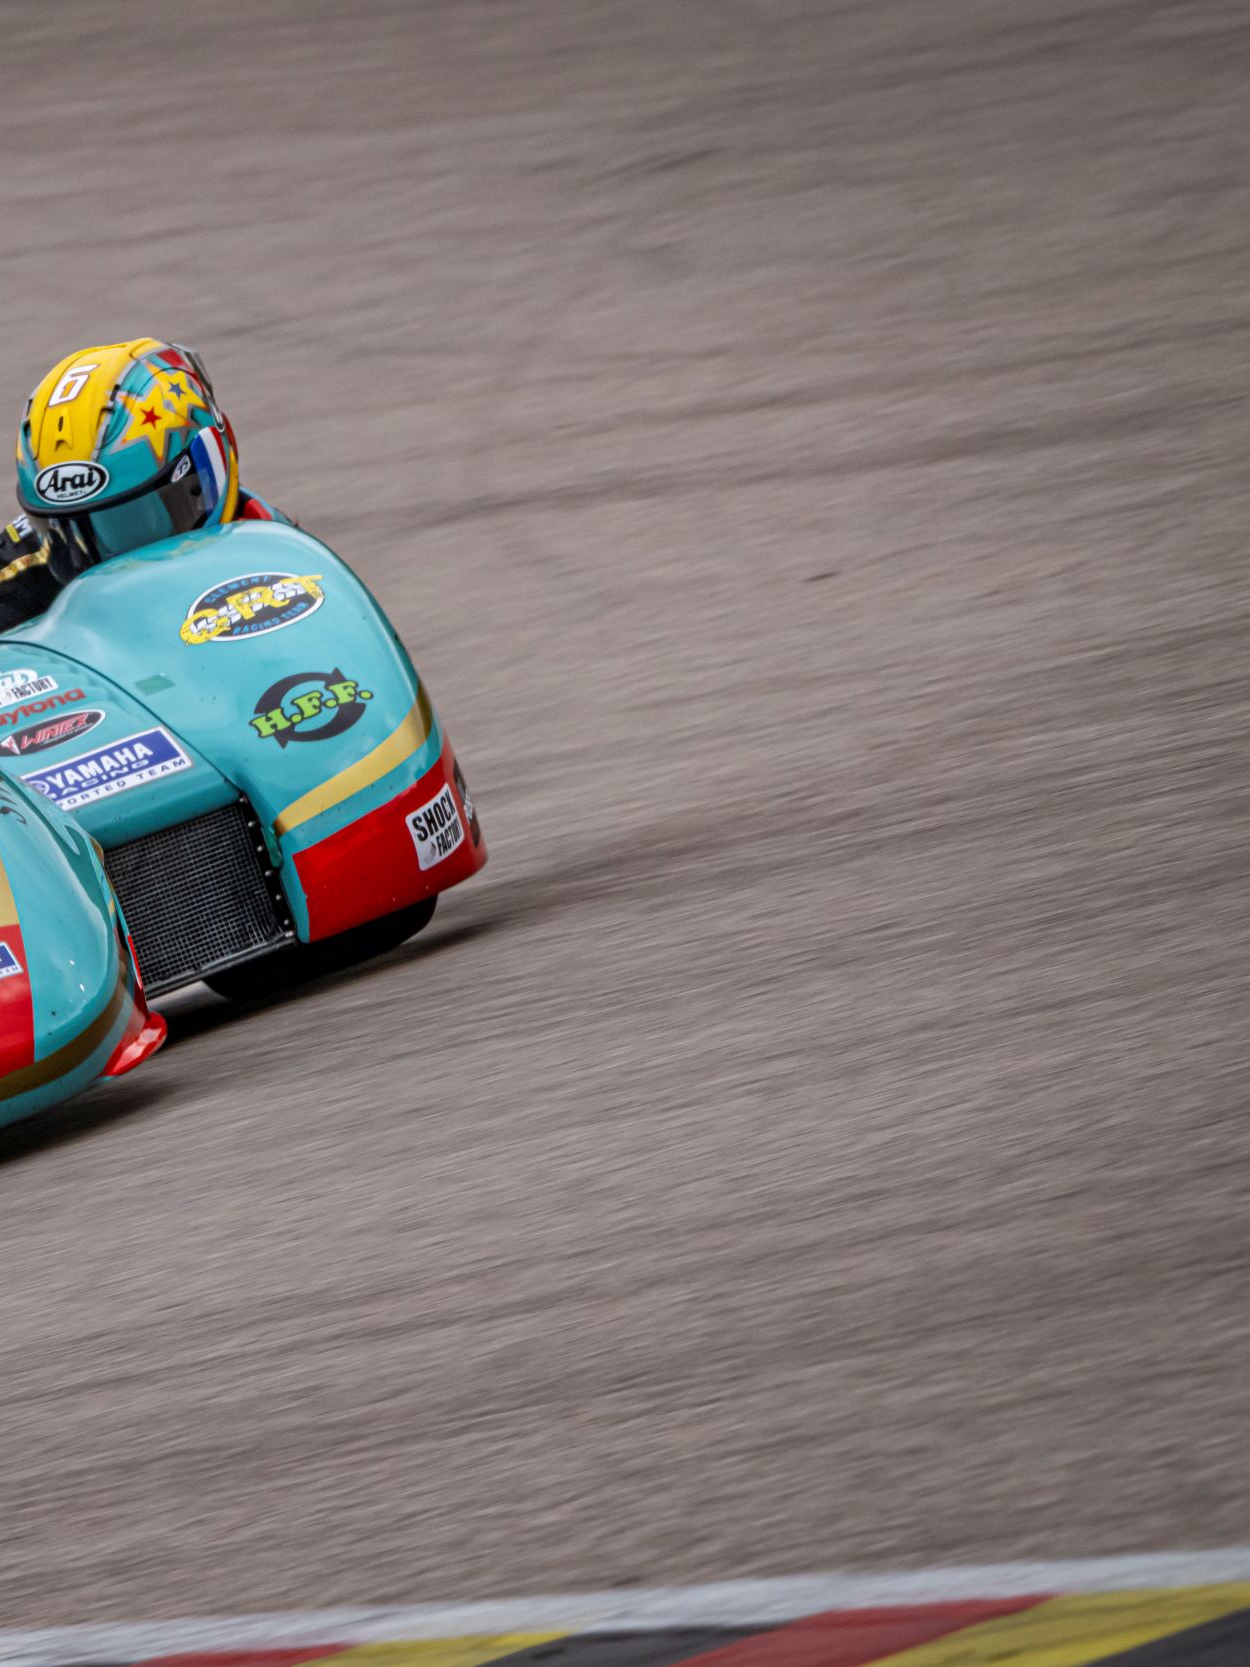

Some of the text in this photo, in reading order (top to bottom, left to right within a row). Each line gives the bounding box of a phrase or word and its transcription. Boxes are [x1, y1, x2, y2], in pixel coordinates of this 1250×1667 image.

[49, 364, 100, 406] 6
[40, 467, 96, 496] Arai
[12, 678, 53, 703] FACTORY
[250, 680, 374, 738] H.F.F.
[46, 742, 154, 789] YAMAHA
[136, 758, 186, 780] TEAM
[412, 788, 456, 842] SHOCK
